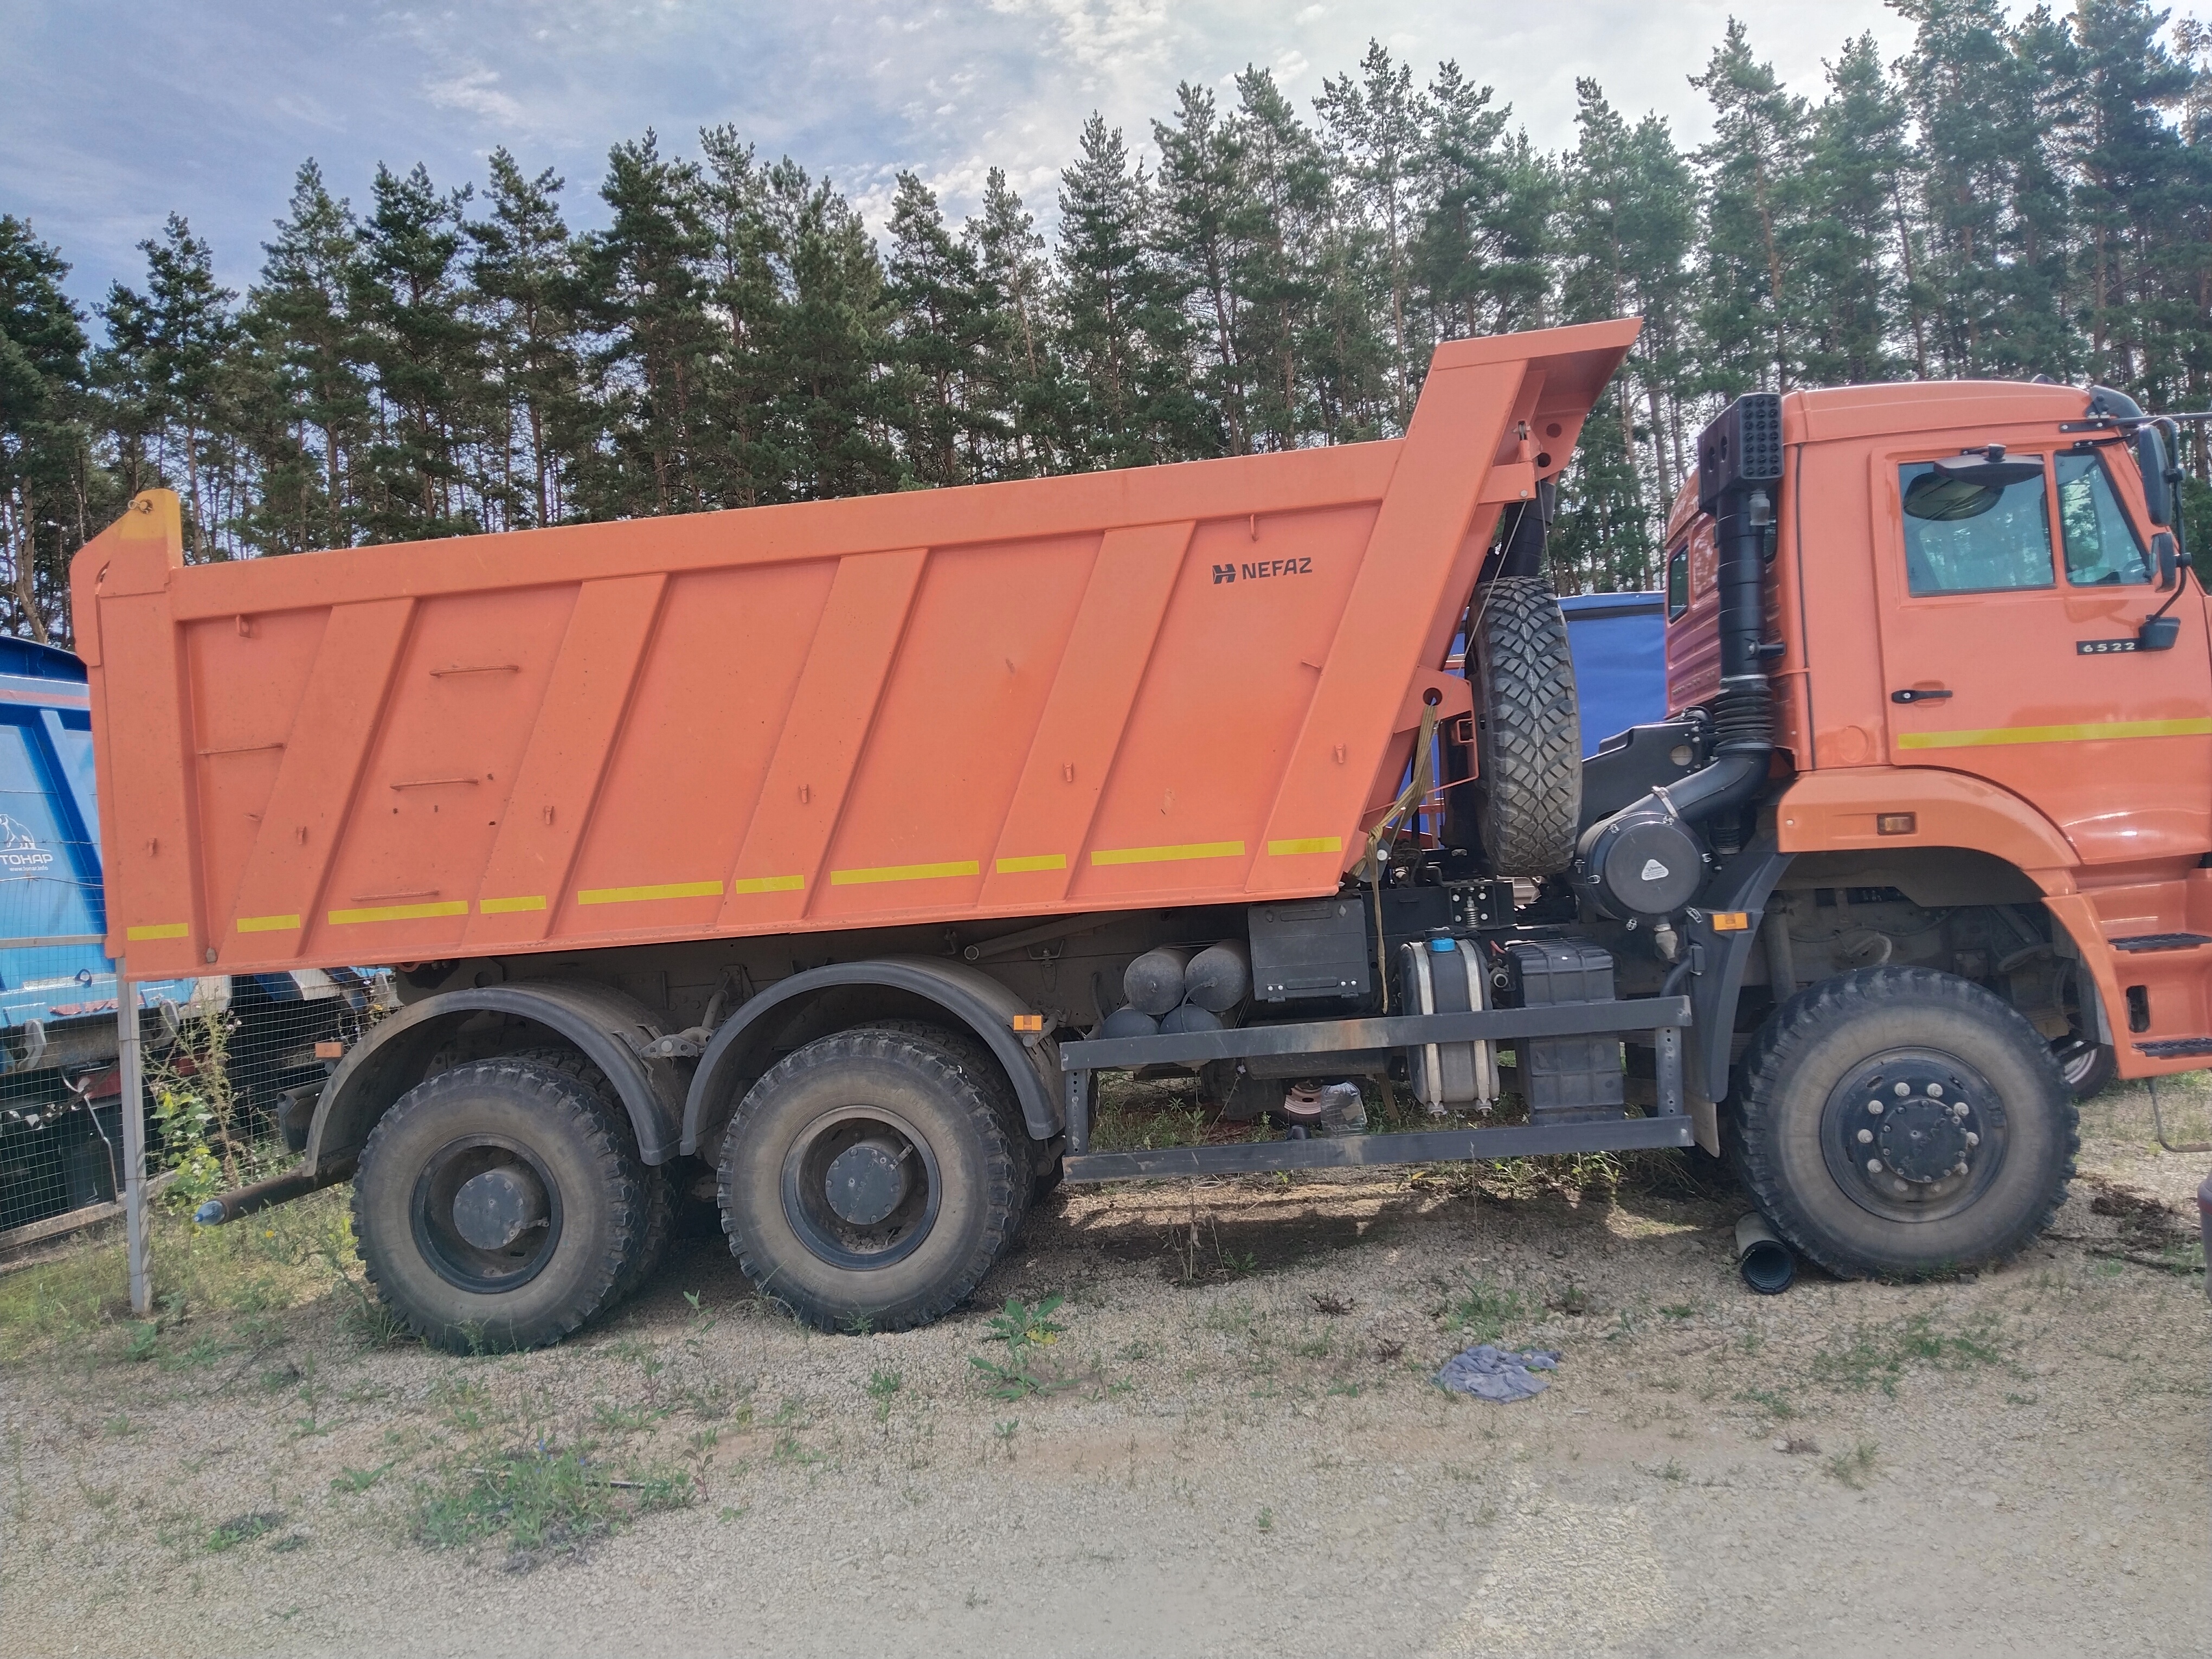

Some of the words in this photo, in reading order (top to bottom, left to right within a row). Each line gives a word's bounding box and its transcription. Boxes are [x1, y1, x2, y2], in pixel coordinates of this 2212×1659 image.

[1242, 557, 1313, 580] NEFAZ
[2084, 642, 2135, 652] 6522
[0, 854, 53, 865] ТОНАР
